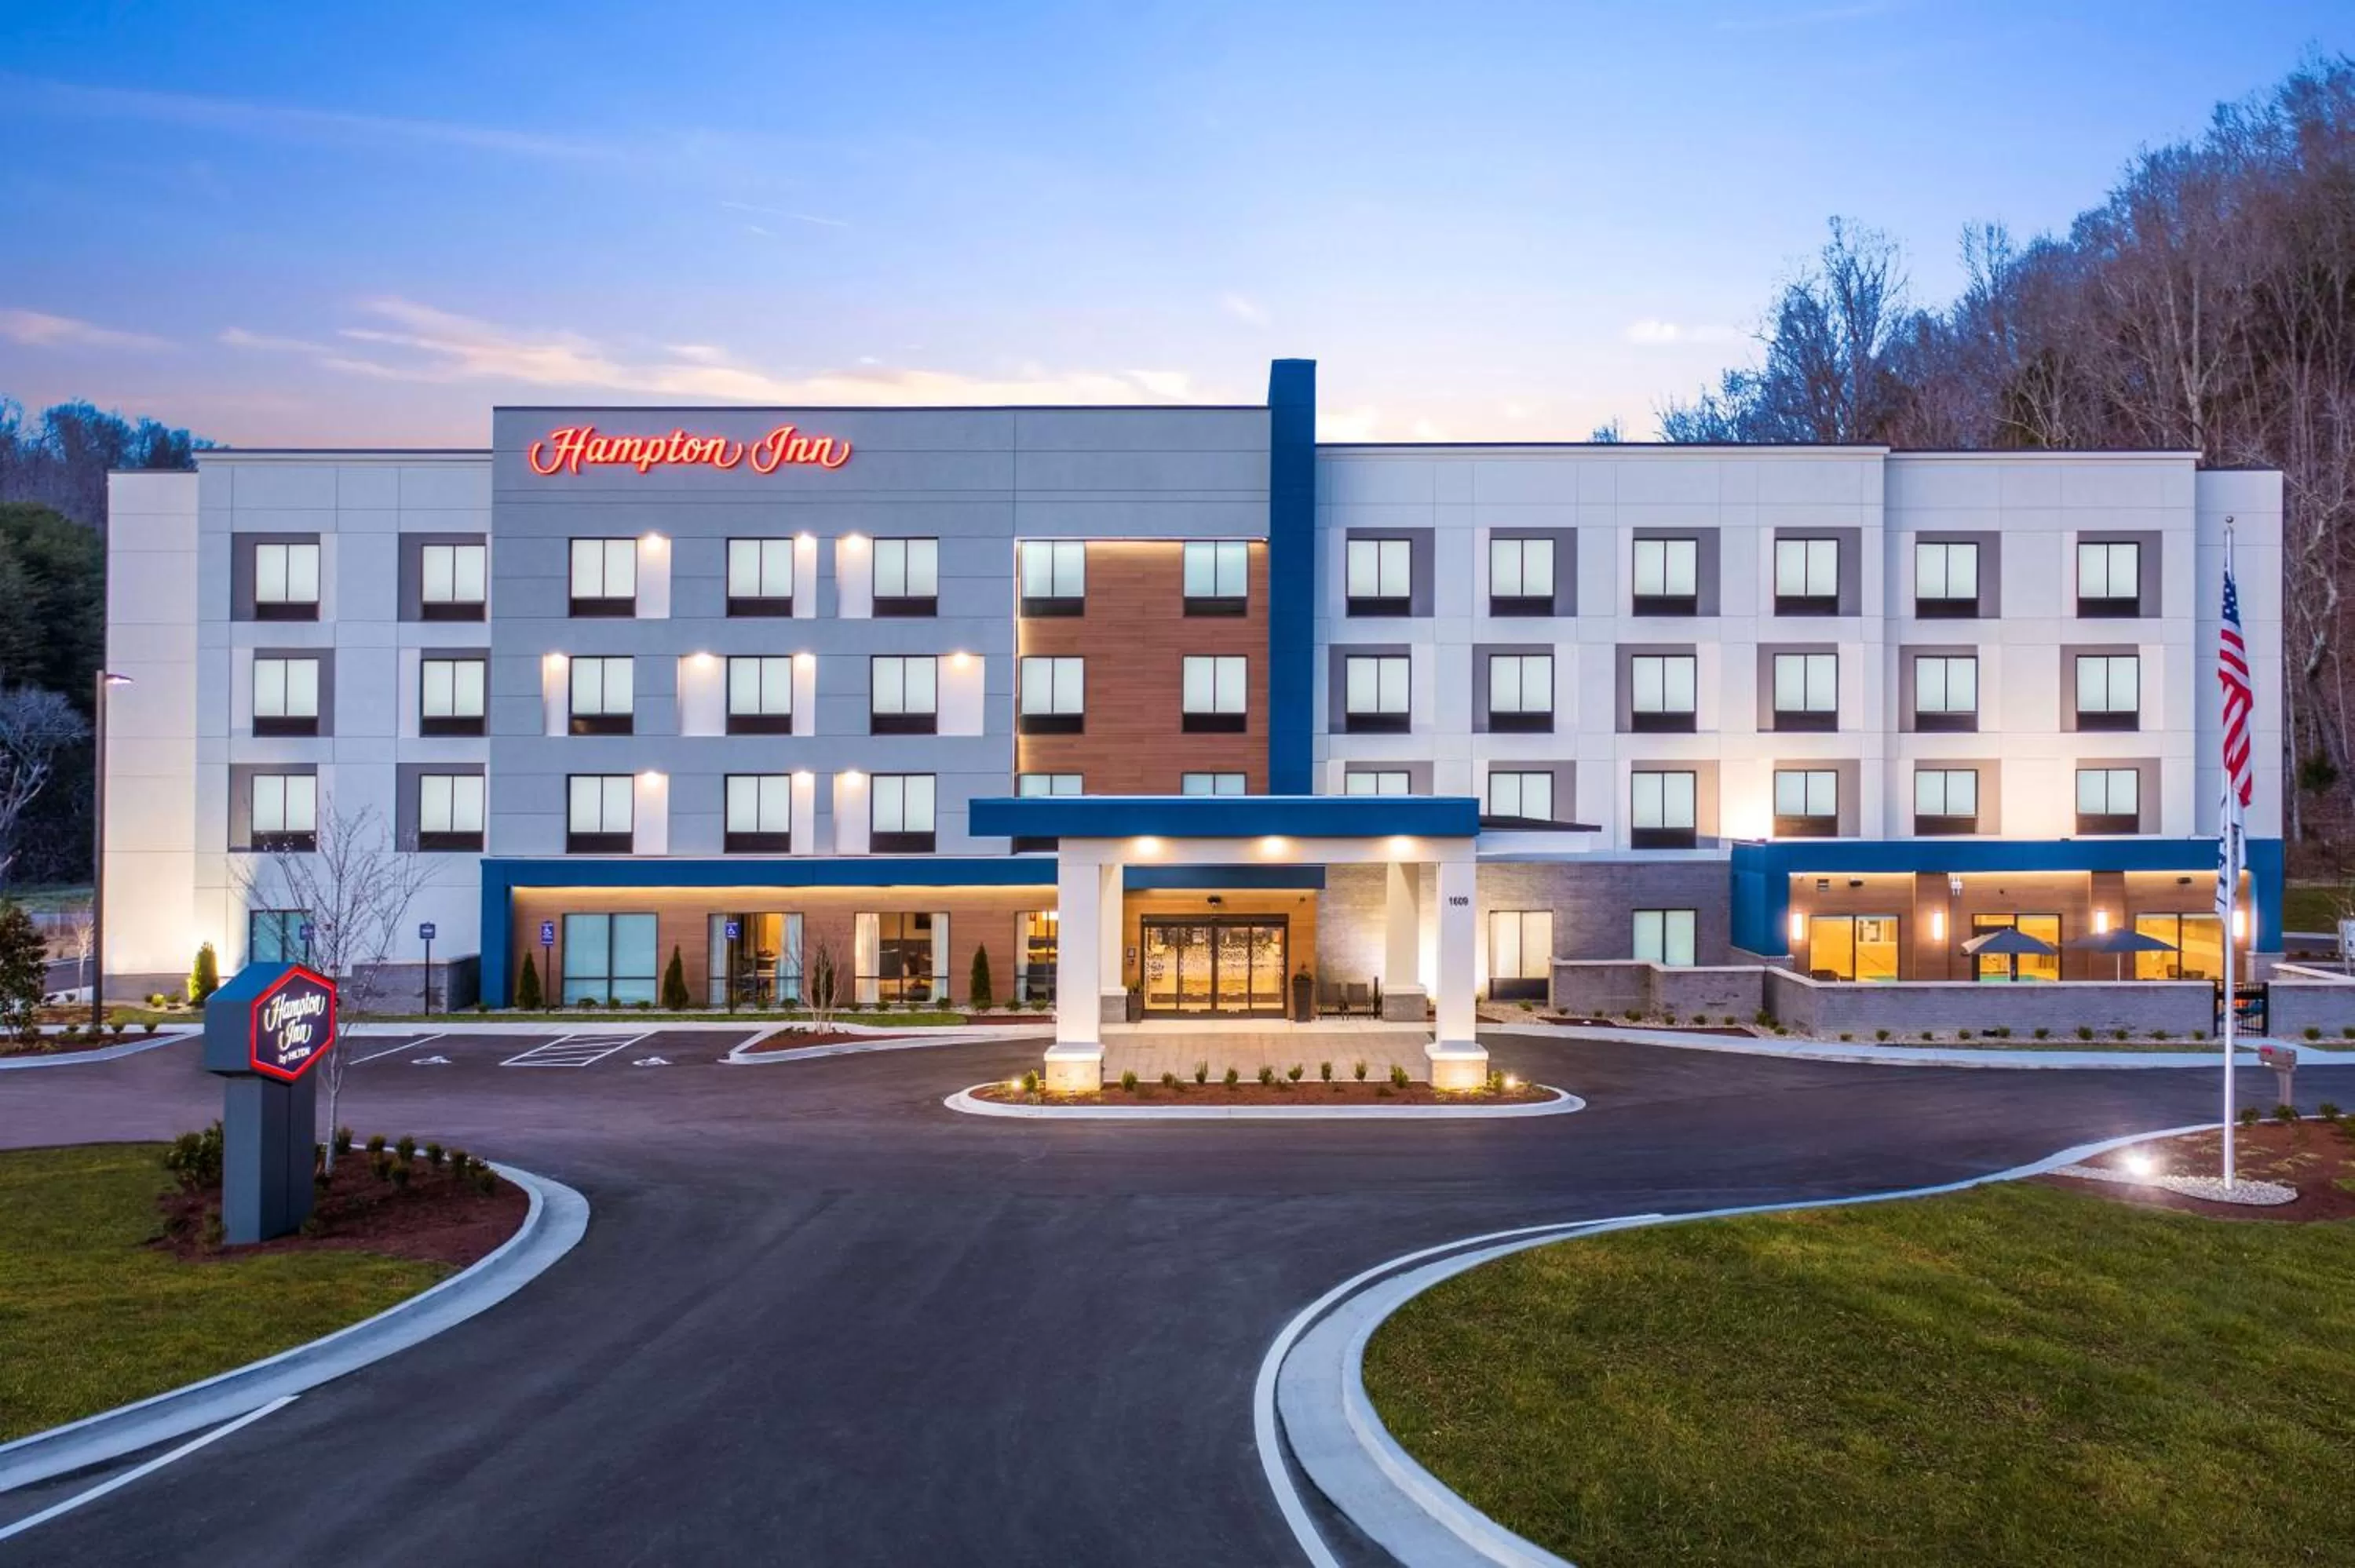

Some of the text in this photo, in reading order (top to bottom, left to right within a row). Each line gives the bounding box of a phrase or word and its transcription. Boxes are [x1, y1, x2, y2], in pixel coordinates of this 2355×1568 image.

[529, 425, 853, 475] Hampton Inn
[1449, 896, 1468, 906] 1609
[264, 992, 325, 1032] Hampton
[278, 1019, 312, 1051] Inn
